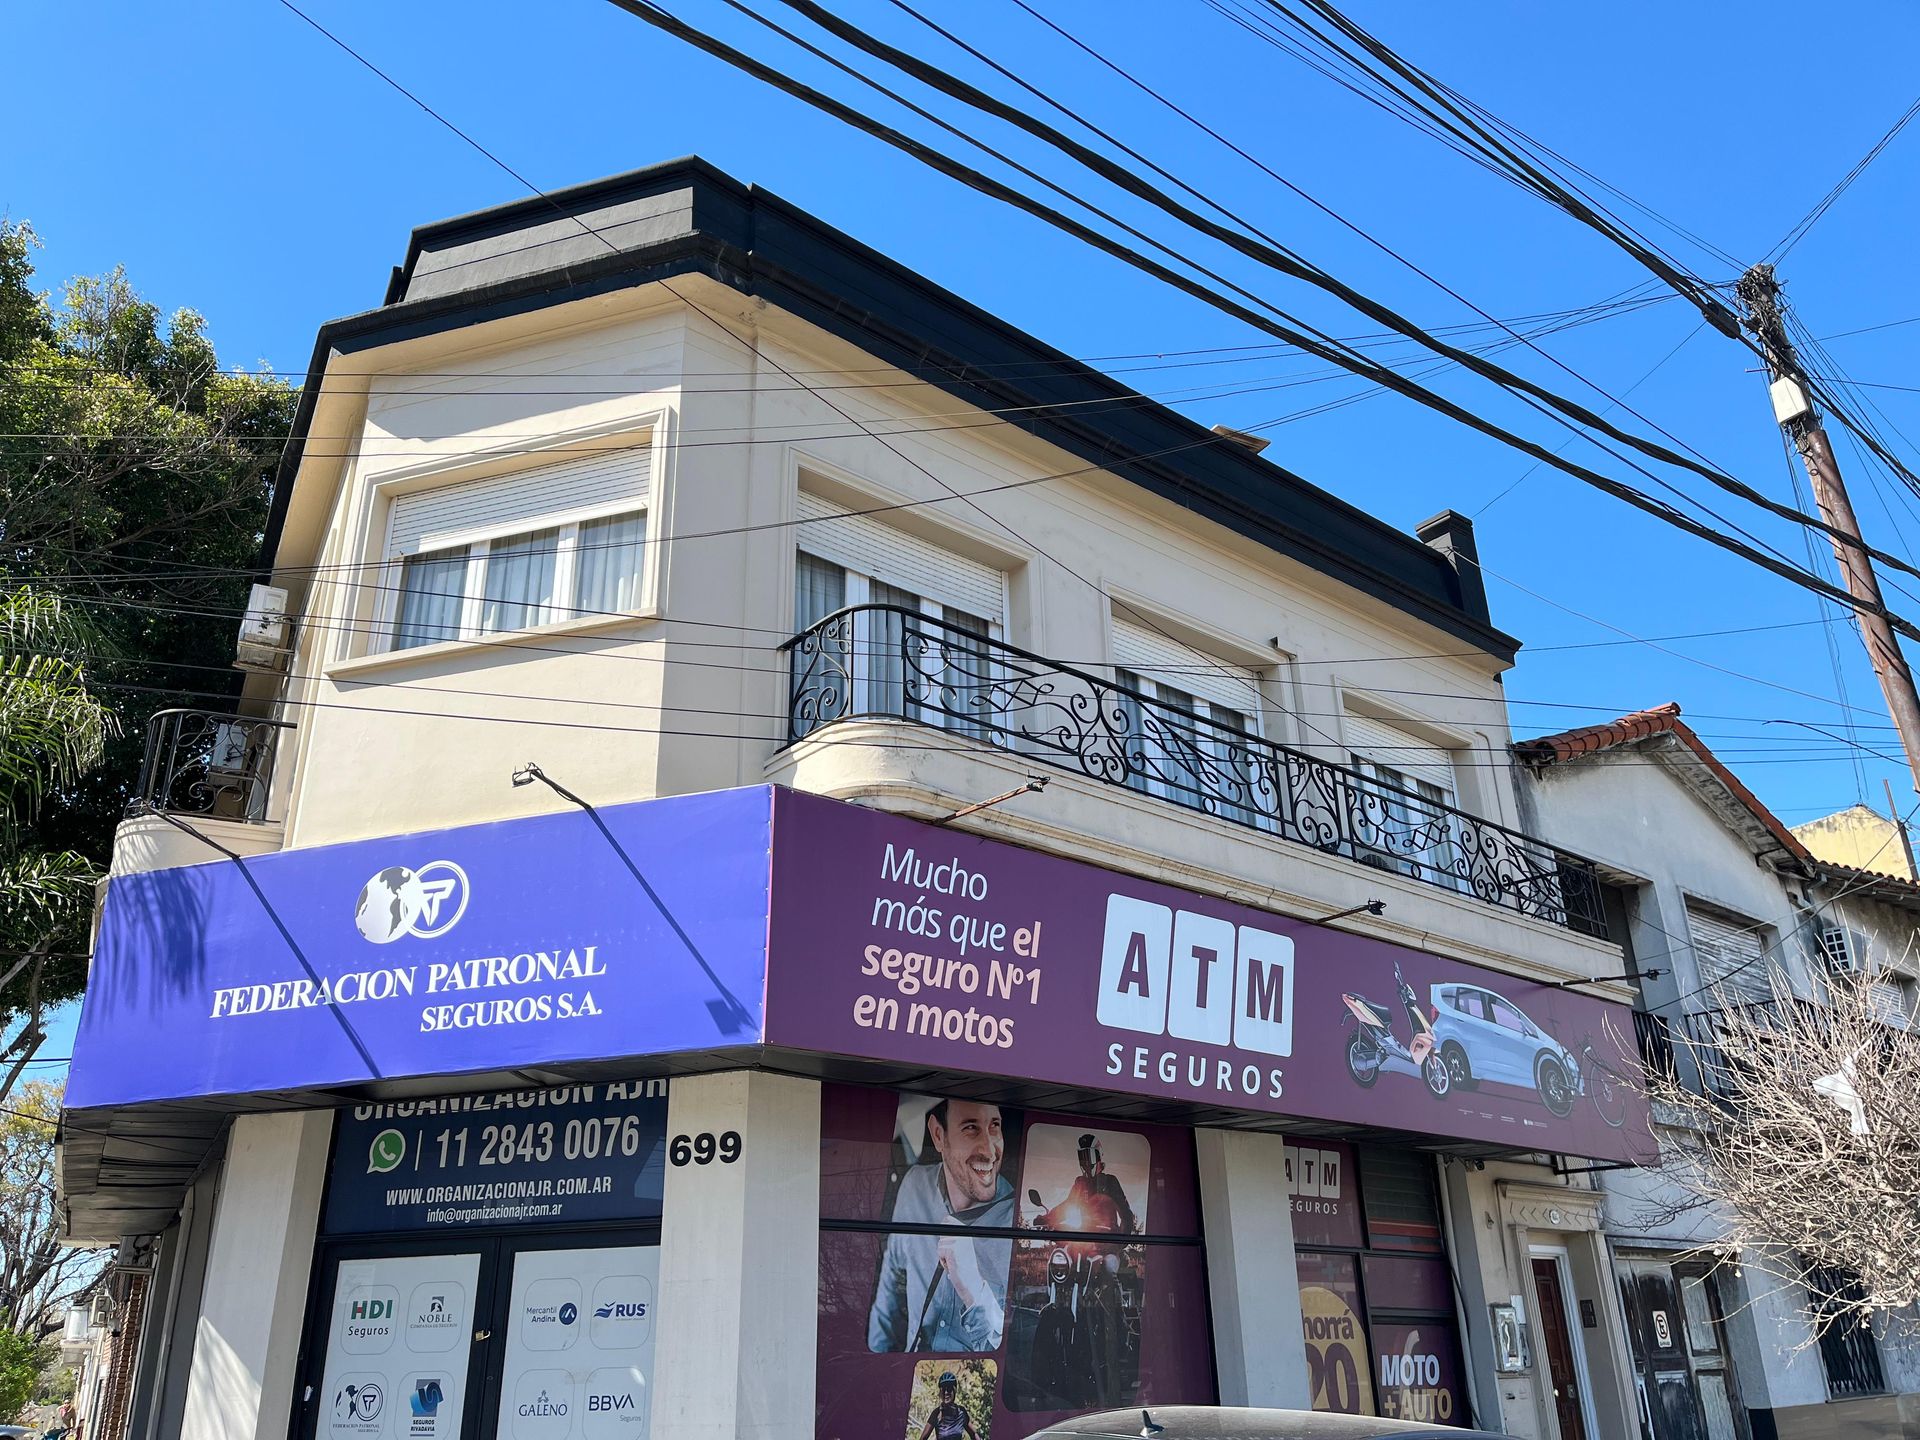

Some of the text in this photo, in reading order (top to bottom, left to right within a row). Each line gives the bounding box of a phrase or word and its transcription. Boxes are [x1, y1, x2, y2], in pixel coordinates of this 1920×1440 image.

[880, 843, 988, 901] Mucho
[871, 895, 1042, 958] más que el
[209, 946, 607, 1019] FEDERACION PATRONAL
[861, 944, 979, 995] seguro
[1117, 931, 1285, 1024] ATM
[420, 990, 603, 1032] SEGUROS S.A.
[853, 994, 1015, 1049] en motos
[1106, 1043, 1284, 1099] SEGUROS
[436, 1115, 640, 1169] 11 2843 0076
[669, 1131, 742, 1168] 699
[386, 1176, 612, 1206] WWW.ORGANIZACIONAJR.COM.AR
[1290, 1199, 1338, 1215] EGUROS
[427, 1203, 563, 1224] info@organizacionajr.com.ar
[351, 1299, 393, 1320] HDI
[418, 1314, 453, 1323] NOBLE
[526, 1306, 557, 1315] Mercantil
[531, 1315, 556, 1323] Andina
[616, 1303, 646, 1317] RUS
[1301, 1309, 1355, 1340] horrá
[348, 1326, 389, 1338] Seguros
[1381, 1354, 1440, 1387] MOTO
[519, 1404, 568, 1417] GALENO
[588, 1394, 634, 1411] BBVA
[1400, 1388, 1453, 1421] AUTO
